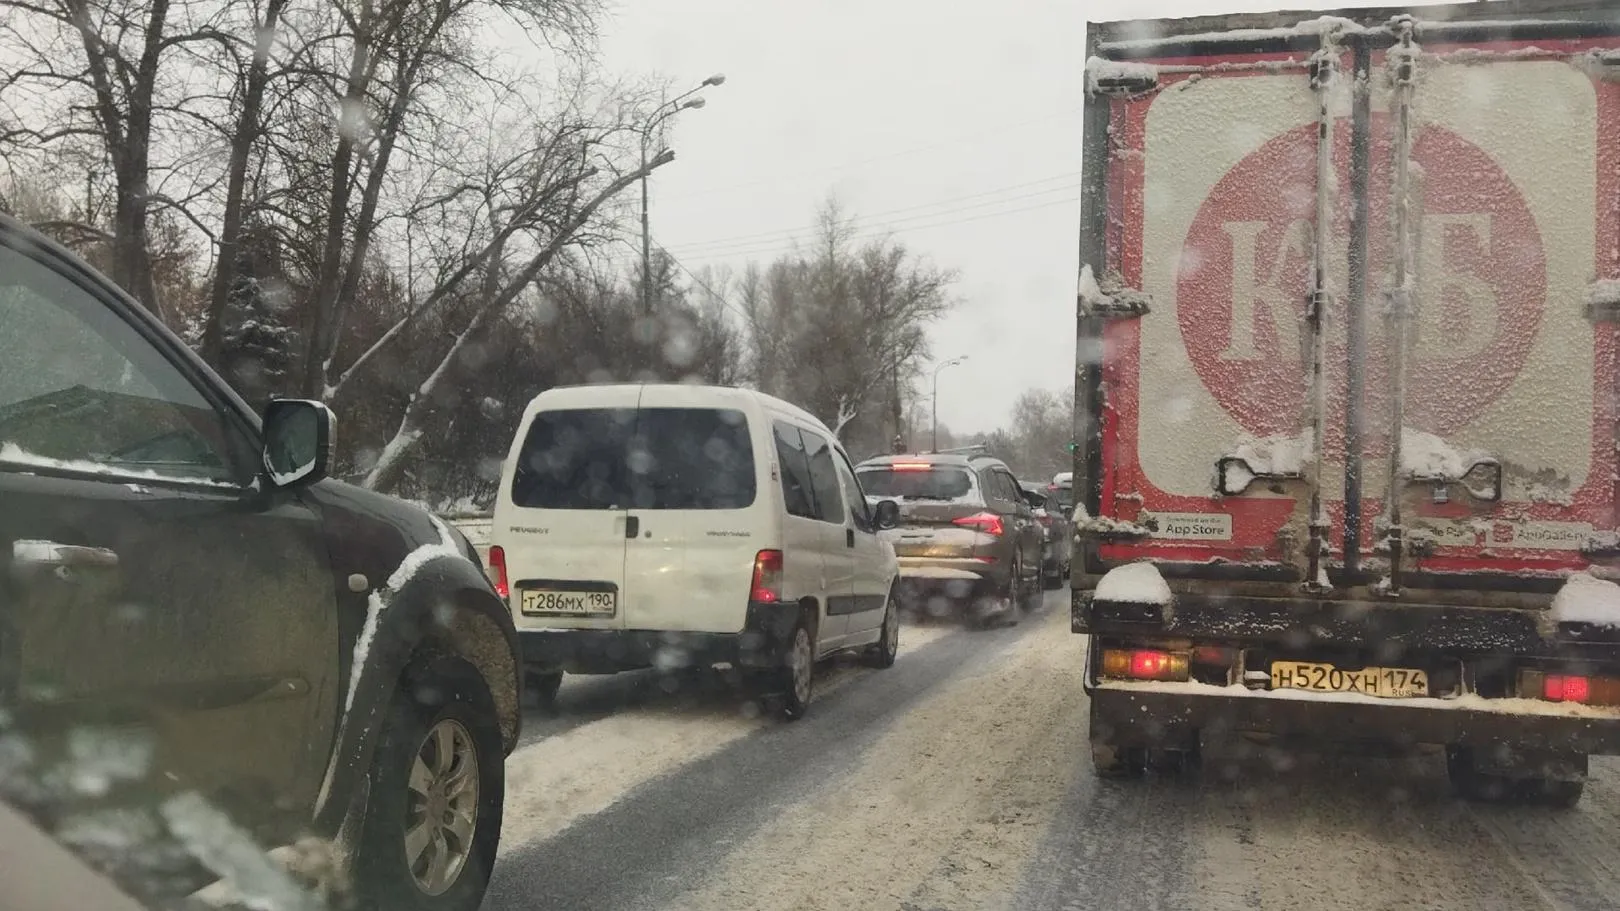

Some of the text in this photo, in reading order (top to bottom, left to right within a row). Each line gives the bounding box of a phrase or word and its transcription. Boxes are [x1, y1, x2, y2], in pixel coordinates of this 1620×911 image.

[1166, 524, 1224, 535] App Store
[588, 593, 612, 606] 190
[1384, 670, 1425, 689] 174
